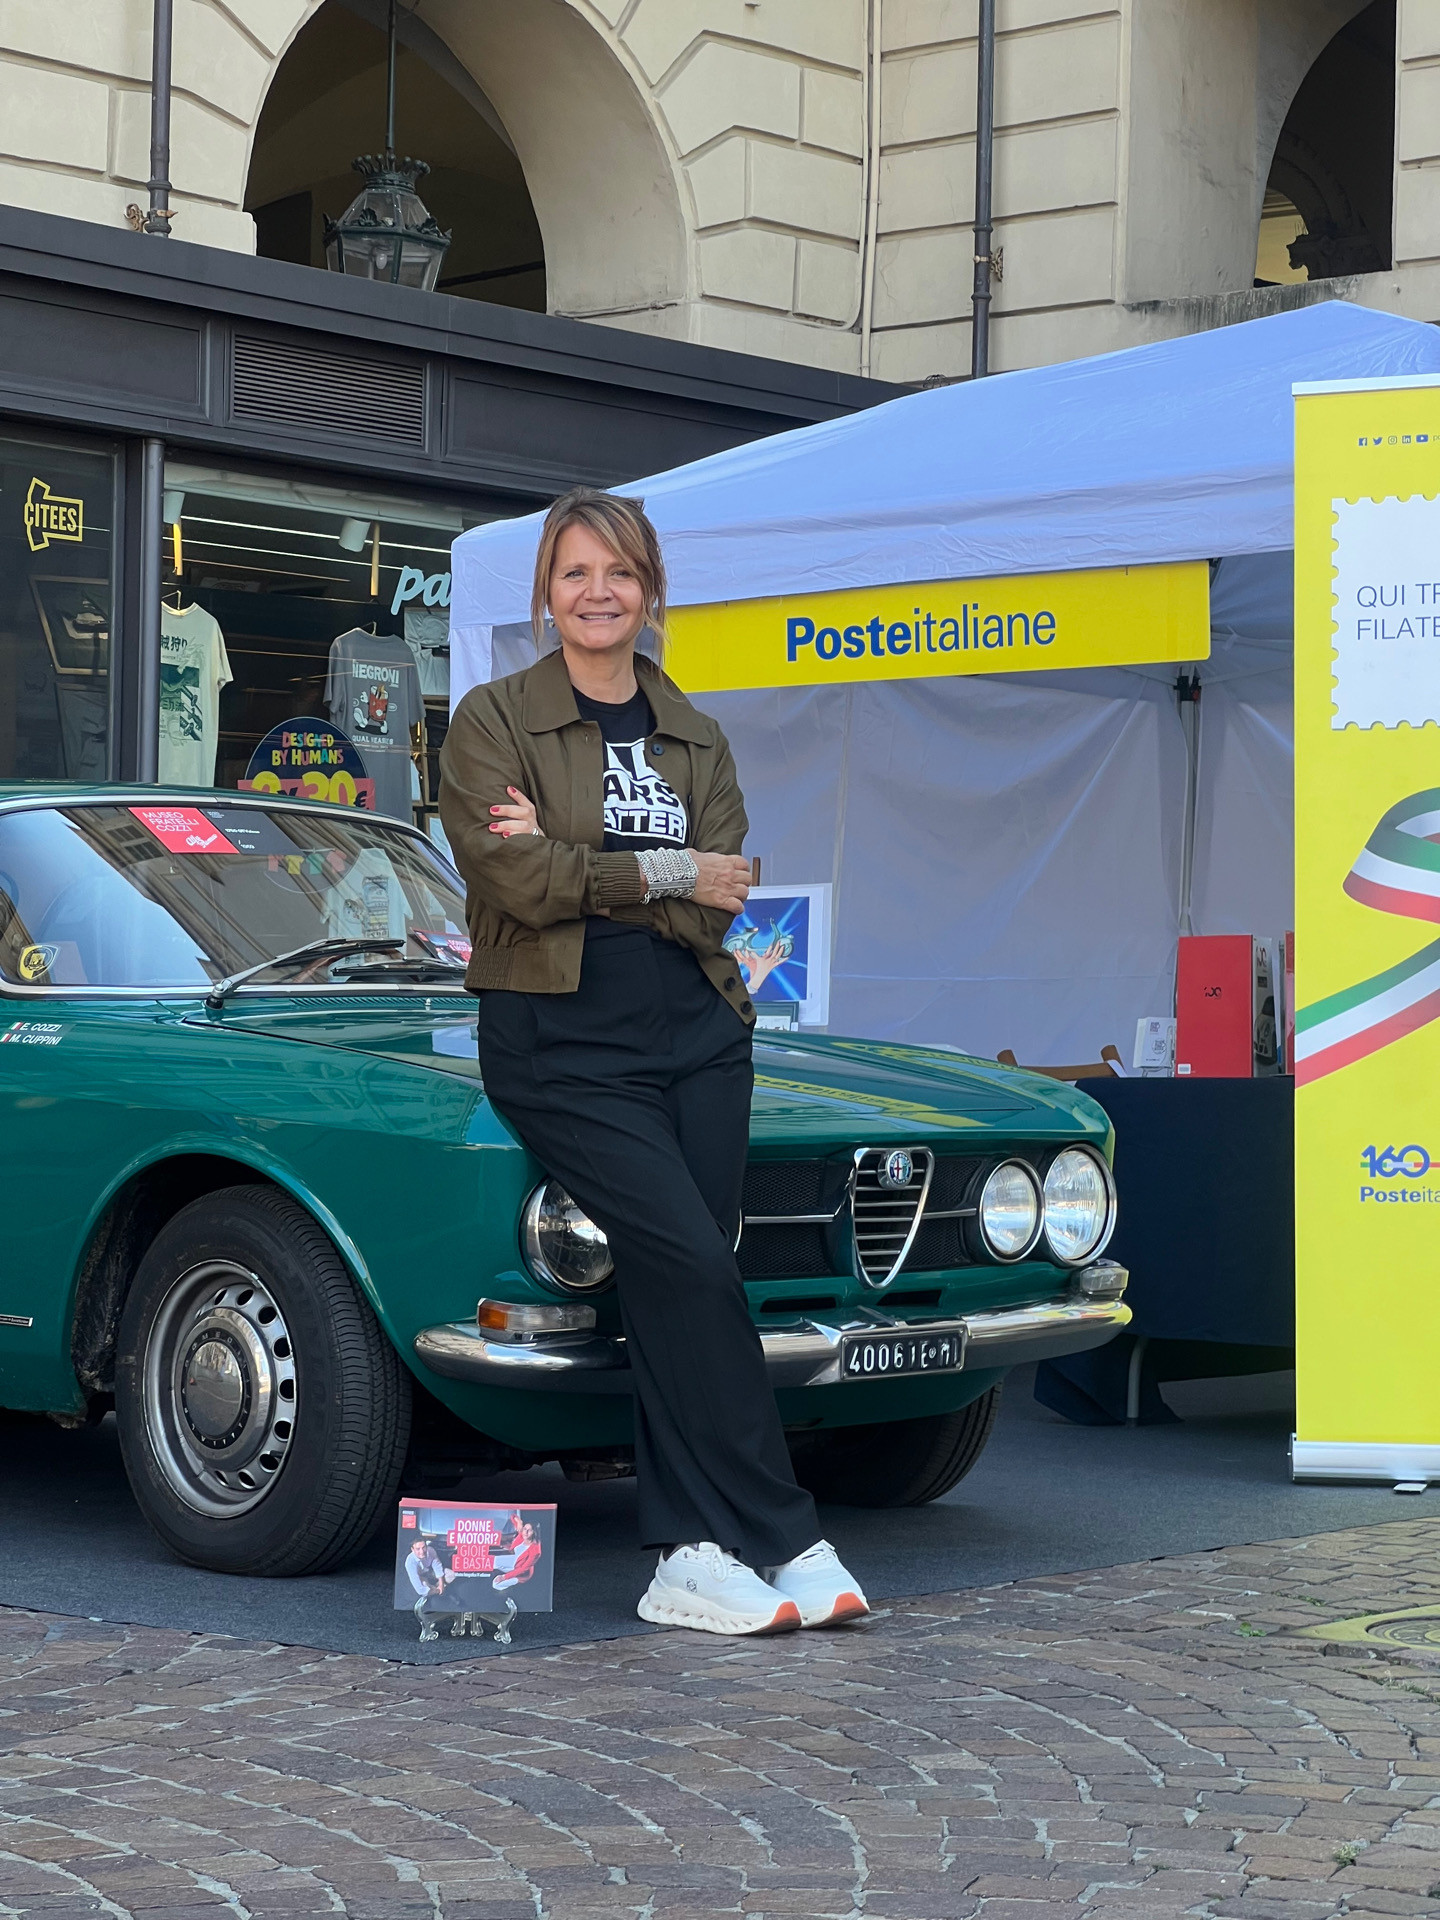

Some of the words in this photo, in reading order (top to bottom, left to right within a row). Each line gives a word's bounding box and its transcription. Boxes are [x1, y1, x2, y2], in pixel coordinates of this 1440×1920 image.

[24, 502, 77, 532] CITEES
[1357, 584, 1405, 608] QUI
[786, 602, 1057, 662] Posteitaliane
[353, 660, 399, 684] NEGRONI
[282, 732, 334, 748] DESIGNED
[272, 749, 288, 766] BY
[291, 748, 344, 766] HUMANS
[142, 811, 184, 819] MUSEO
[148, 818, 200, 826] FRATELLI
[31, 1023, 62, 1032] COZZI
[22, 1034, 62, 1046] CUPPINI
[1361, 1144, 1430, 1178] 160
[457, 1520, 492, 1532] DONNE
[449, 1532, 456, 1544] E
[457, 1532, 499, 1545] MOTORI?
[460, 1544, 486, 1557] GIOIE
[454, 1556, 460, 1569] E
[463, 1557, 493, 1570] BASTA
